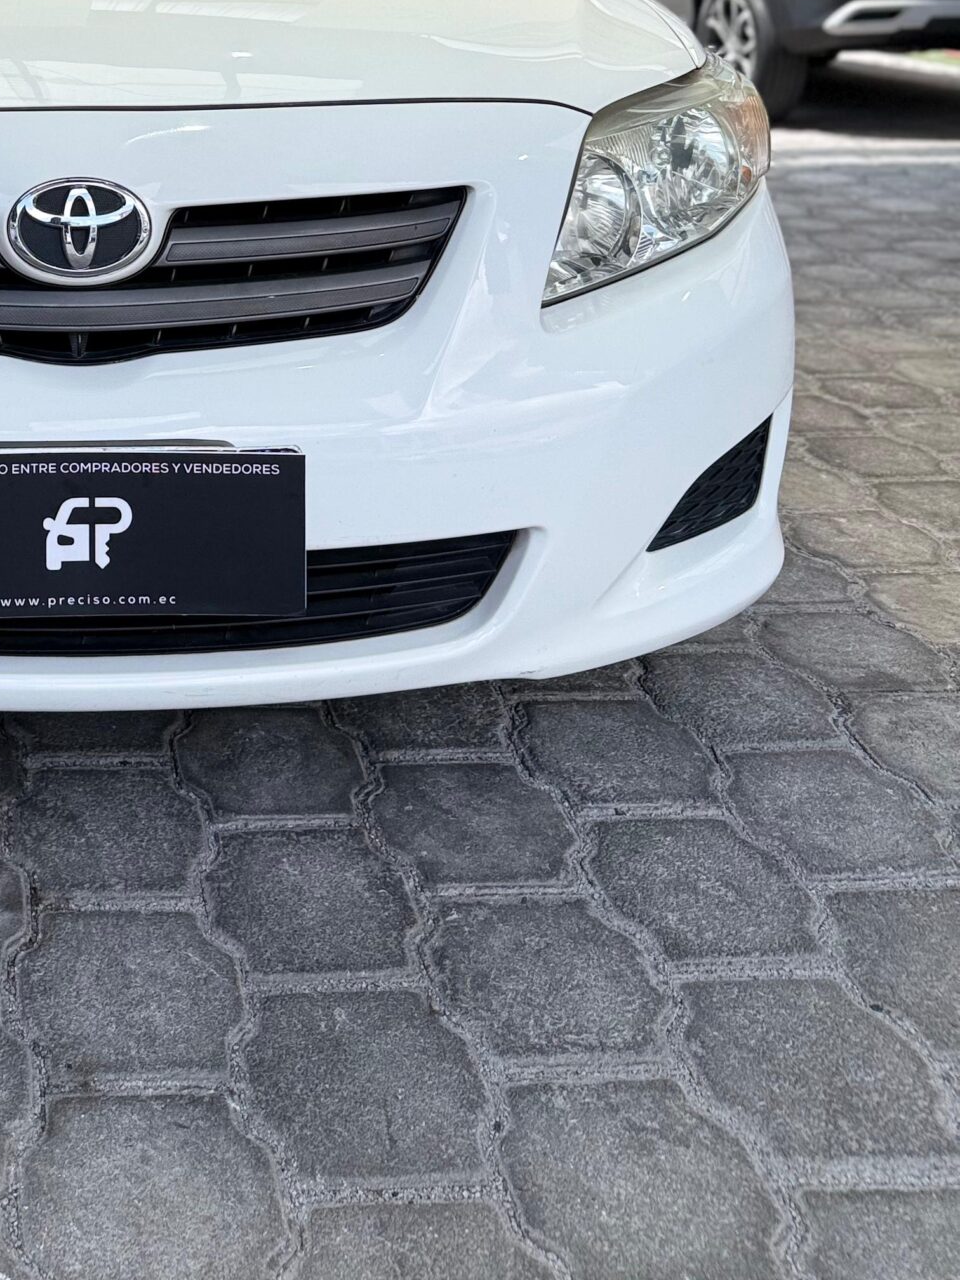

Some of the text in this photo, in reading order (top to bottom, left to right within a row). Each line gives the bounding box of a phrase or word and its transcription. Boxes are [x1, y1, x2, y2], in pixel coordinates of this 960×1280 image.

[11, 462, 57, 475] ENTRE
[59, 462, 170, 474] COMPRADORES
[171, 463, 181, 474] Y
[183, 463, 280, 475] VENDEDORES
[0, 593, 177, 608] www.preciso.com.ec
